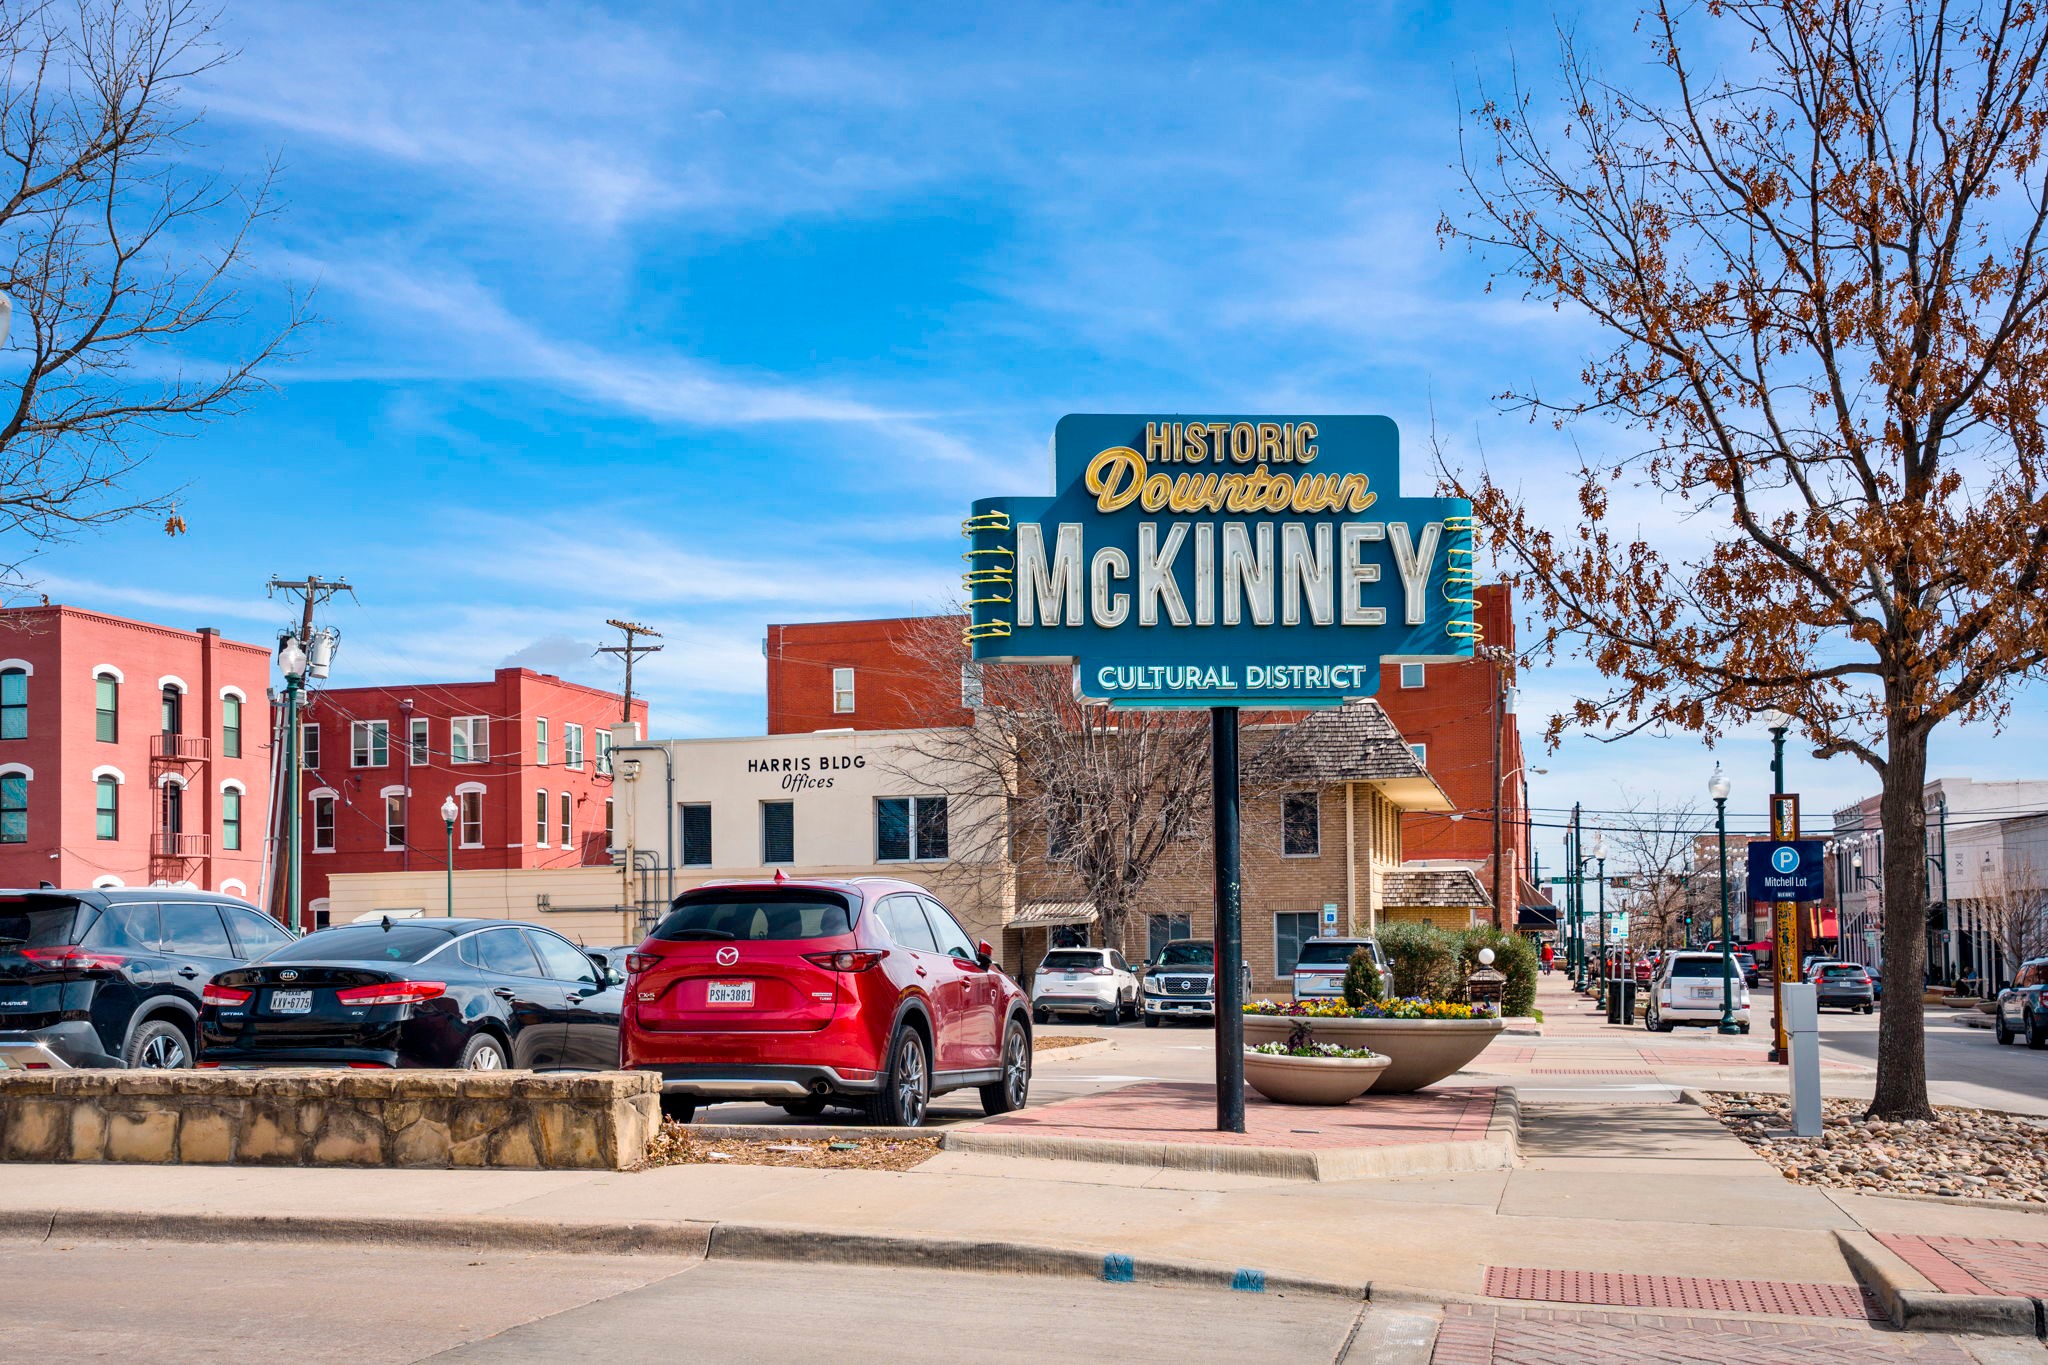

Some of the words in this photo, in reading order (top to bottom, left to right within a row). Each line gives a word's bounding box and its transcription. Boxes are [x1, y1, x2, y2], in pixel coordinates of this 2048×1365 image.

[1145, 421, 1319, 464] HISTORIC
[1085, 446, 1377, 514] Downtown
[1016, 522, 1444, 629] McKINNEY
[1097, 665, 1238, 690] CULTURAL
[1246, 664, 1367, 689] DISTRICT
[748, 757, 811, 773] HARRIS
[819, 755, 866, 770] BLDG
[781, 773, 835, 793] Offices
[1780, 851, 1794, 869] P
[1764, 876, 1795, 887] Mitchell
[1795, 876, 1808, 887] Lot
